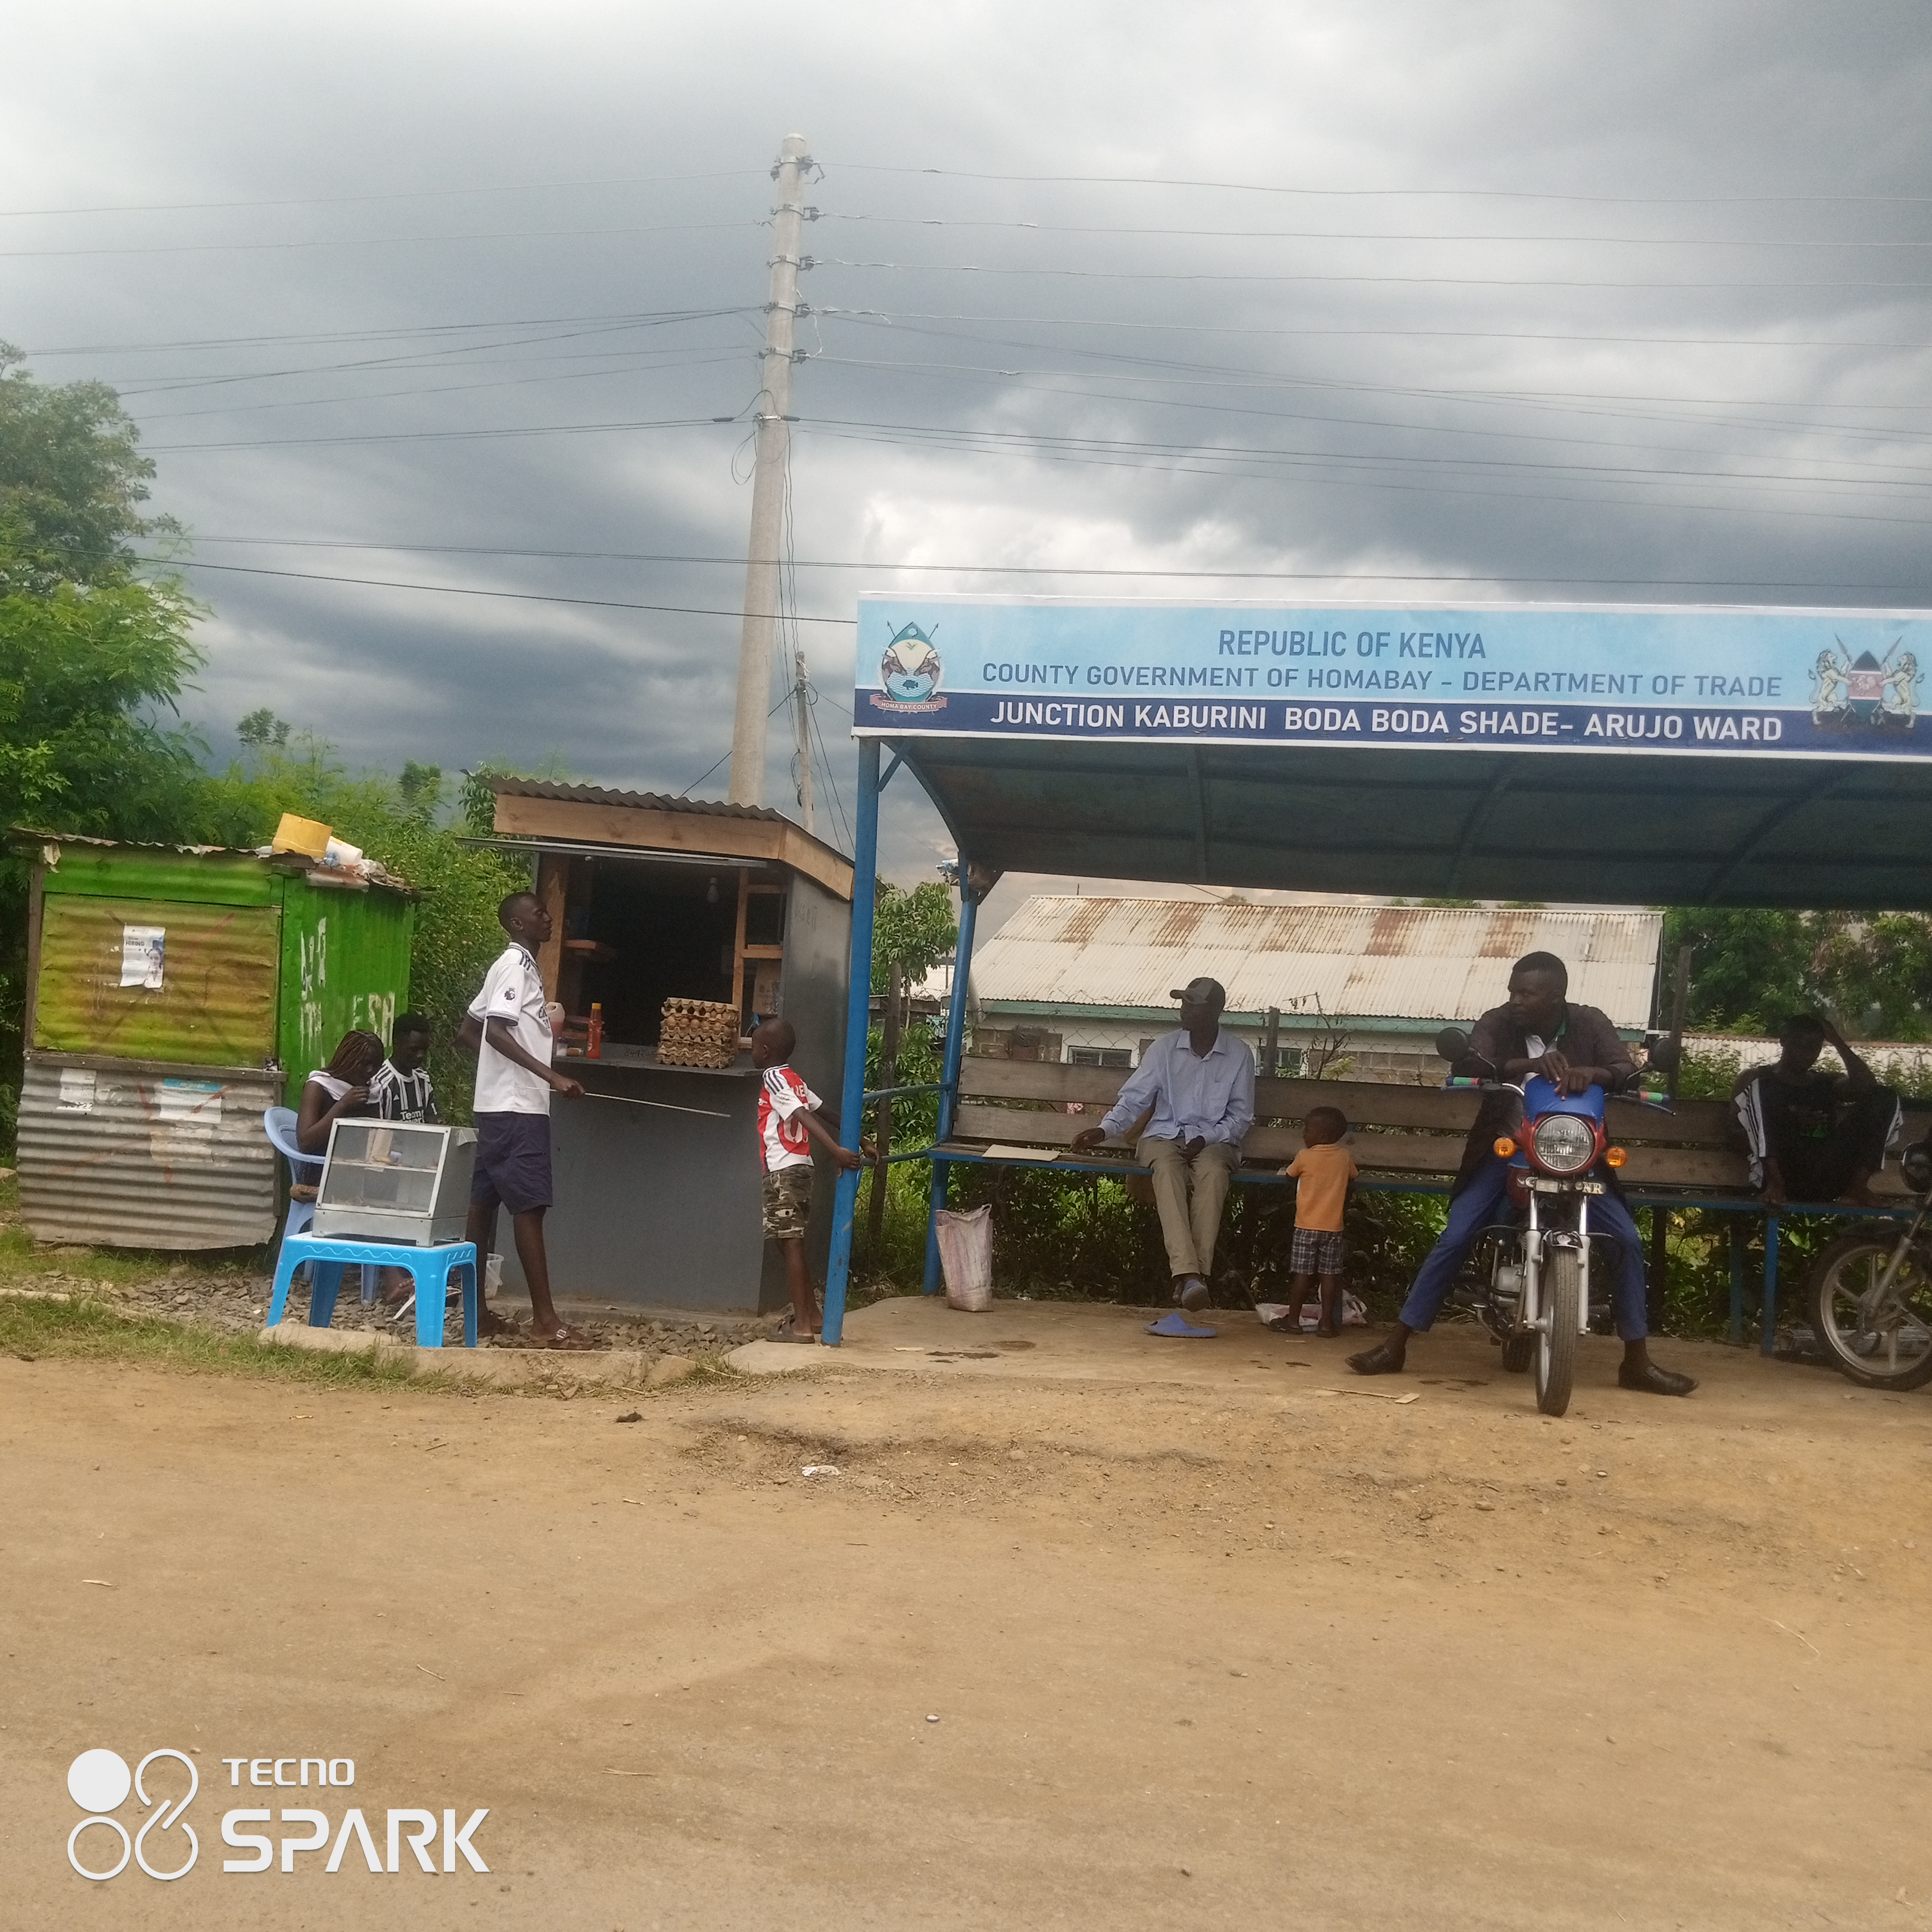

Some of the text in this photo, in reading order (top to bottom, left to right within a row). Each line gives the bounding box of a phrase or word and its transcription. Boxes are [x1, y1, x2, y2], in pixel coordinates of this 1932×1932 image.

[1218, 629, 1486, 659] REPUBLIC OF KENYA
[983, 662, 1079, 685] COUNTY
[1087, 665, 1259, 687] GOVERNMENT
[1267, 668, 1299, 688] OF
[1308, 669, 1433, 690] HOMABAY
[1463, 671, 1644, 694] DEPARTMENT
[1651, 675, 1686, 695] OF
[1693, 675, 1783, 697] TRADE
[990, 701, 1782, 741] JUNCTION KABURINI BODA BODA SHADE- ARUJO WARD
[400, 1110, 422, 1121] Team
